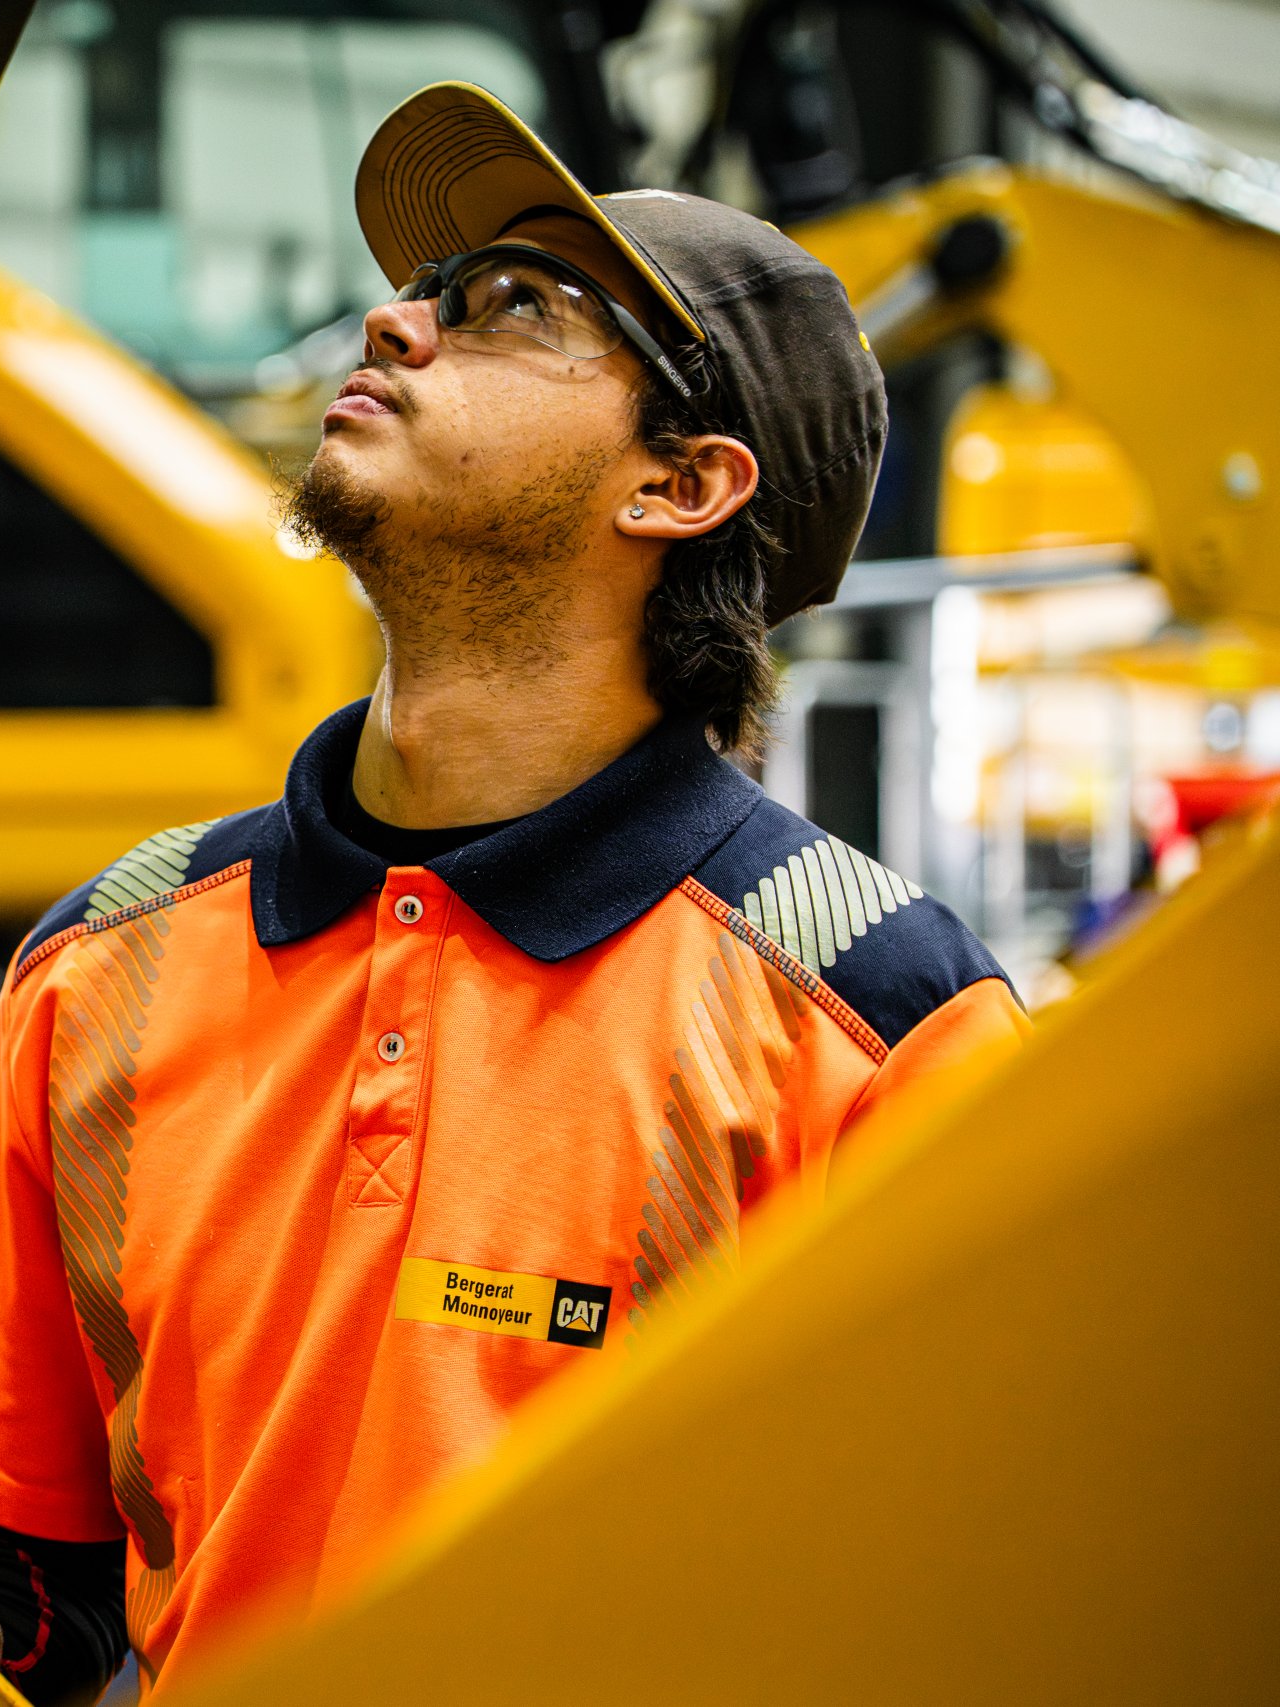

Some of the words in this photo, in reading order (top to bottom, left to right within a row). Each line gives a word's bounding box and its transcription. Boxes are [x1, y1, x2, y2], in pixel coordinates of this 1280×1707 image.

[446, 1272, 514, 1300] Bergerat
[442, 1295, 533, 1325] Monnoyeur
[556, 1297, 604, 1333] CAT
